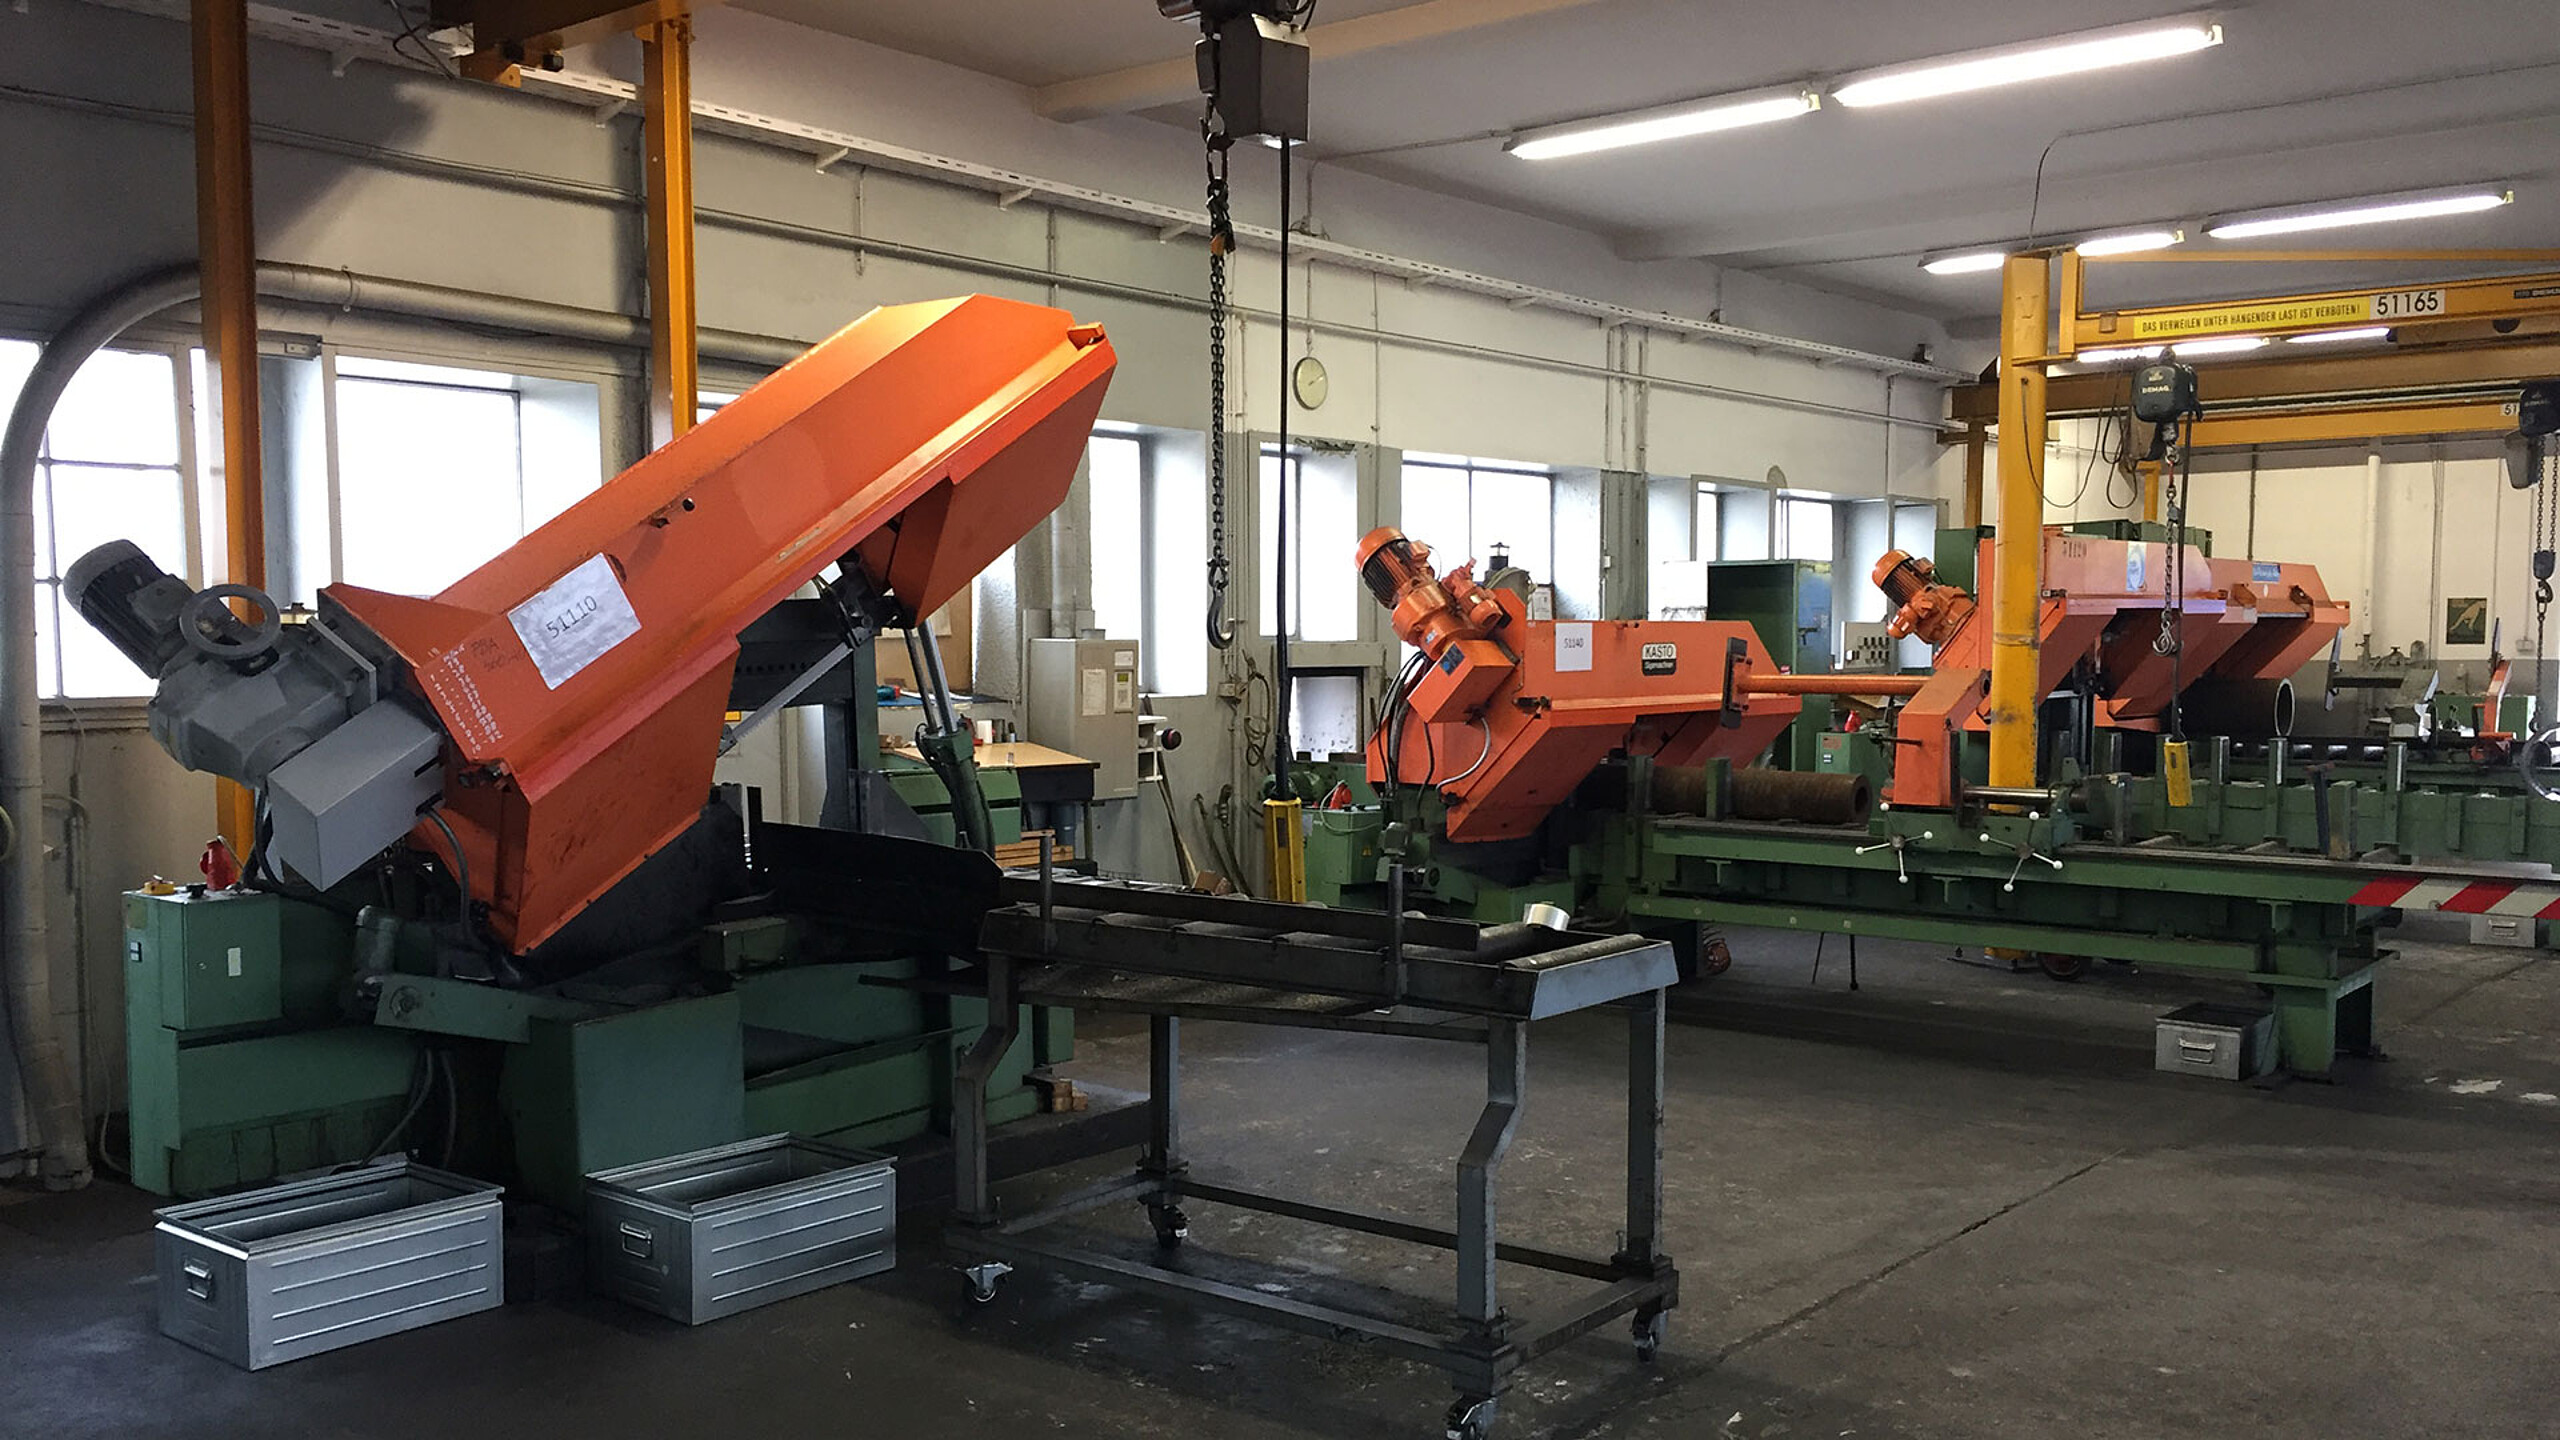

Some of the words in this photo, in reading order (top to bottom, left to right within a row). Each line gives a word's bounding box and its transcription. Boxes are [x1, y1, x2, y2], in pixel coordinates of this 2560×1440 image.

[2377, 292, 2438, 316] 51165
[2142, 321, 2157, 333] DAS
[2159, 318, 2201, 331] VERWEILEN
[2203, 316, 2229, 328] UNTER
[2278, 308, 2297, 321] LAST
[2300, 307, 2312, 320] IST
[2315, 303, 2361, 318] VERBOTEN!
[545, 595, 598, 639] 51110
[1563, 638, 1585, 649] 51140
[1644, 645, 1674, 658] KASTO
